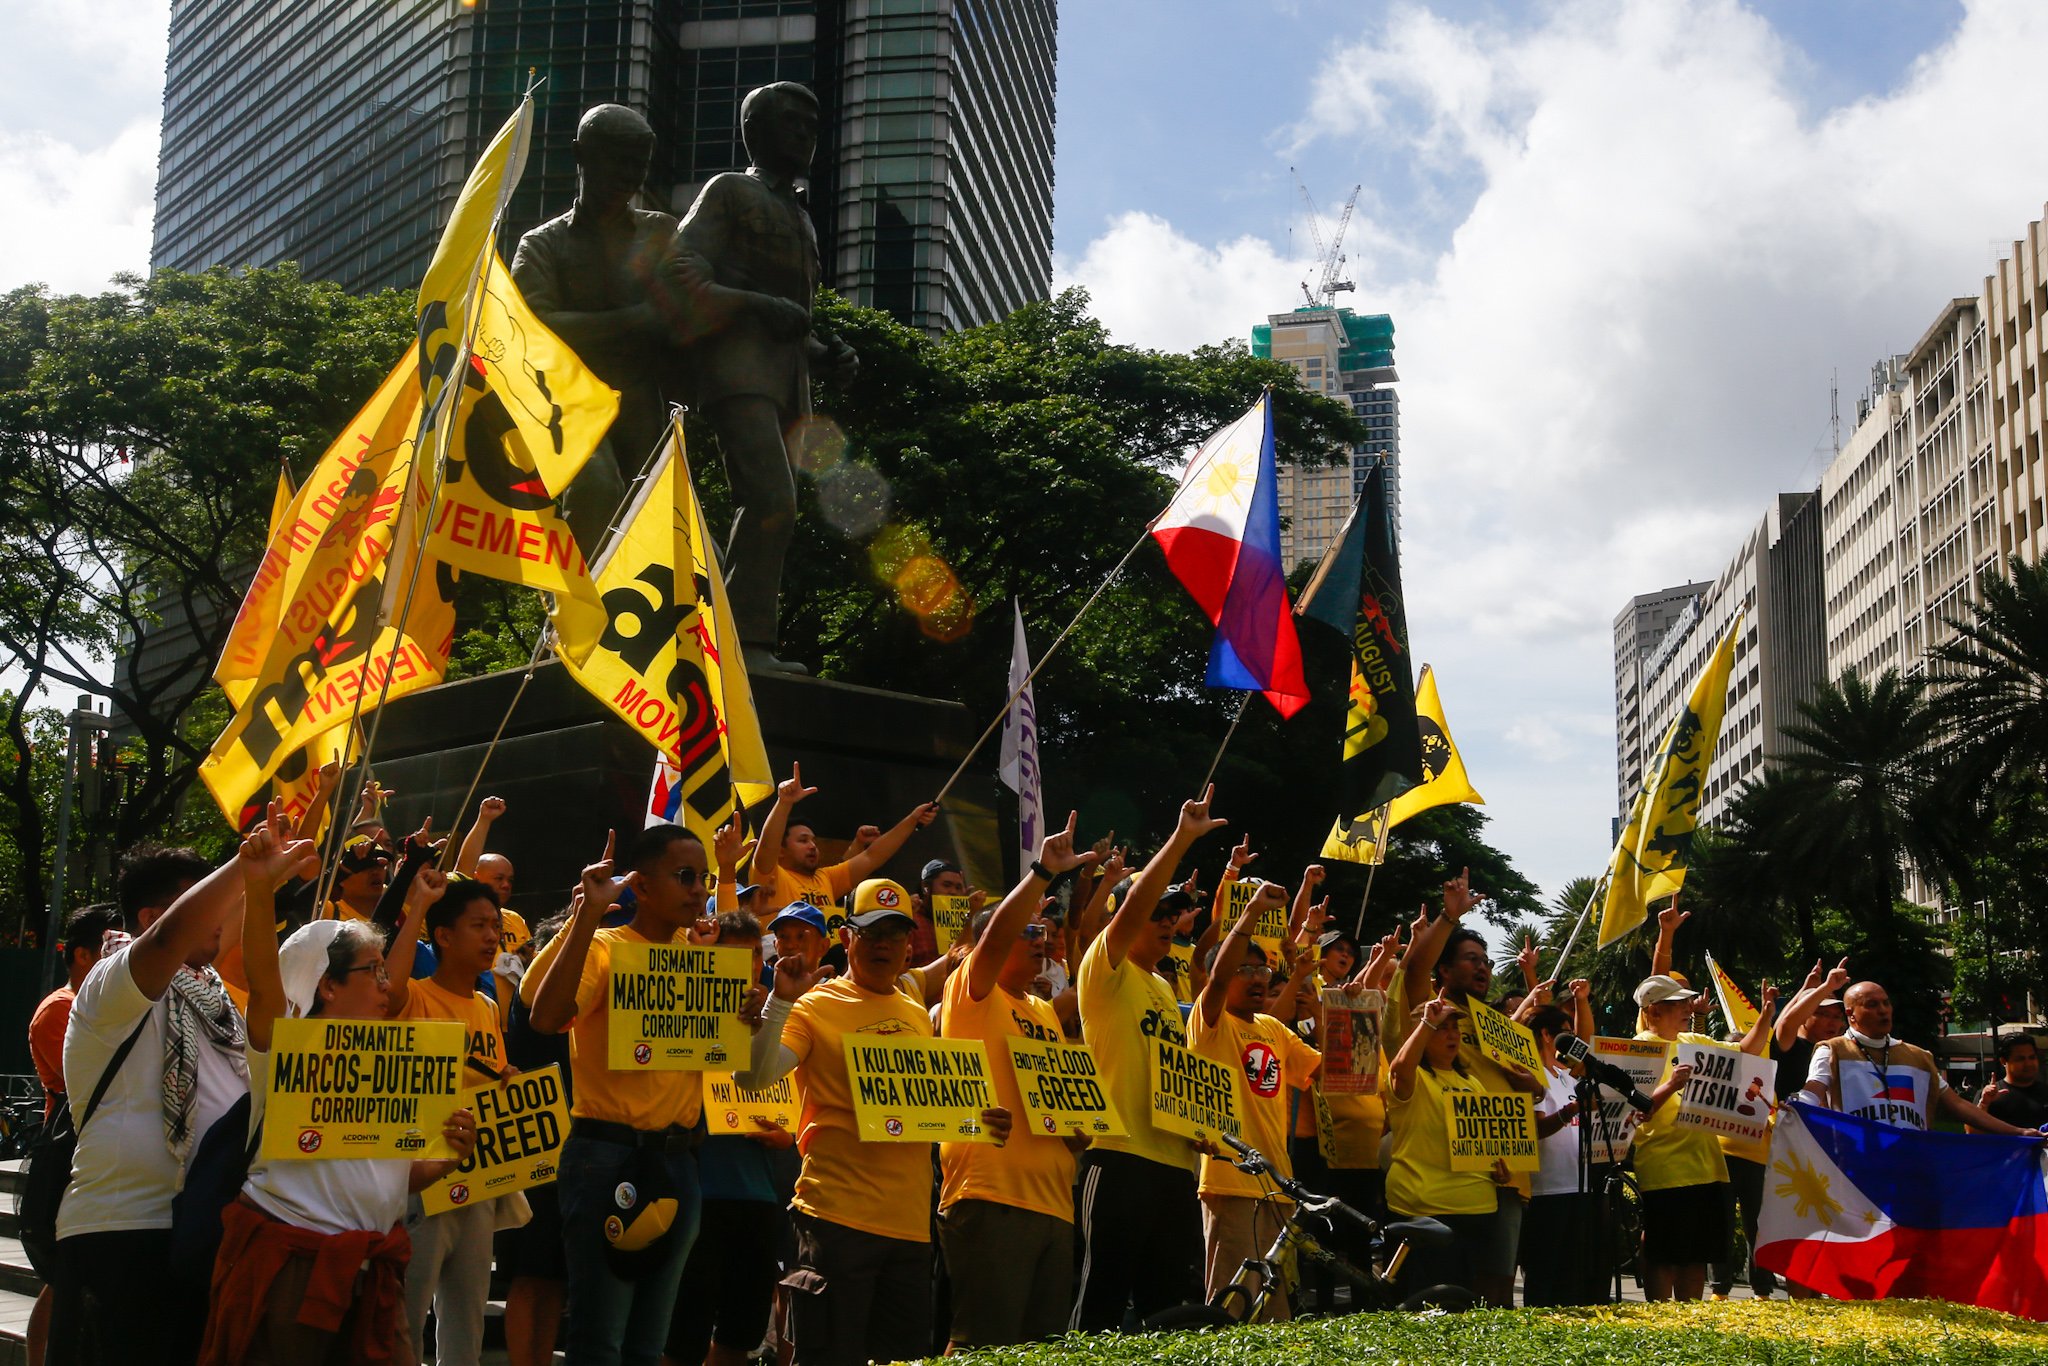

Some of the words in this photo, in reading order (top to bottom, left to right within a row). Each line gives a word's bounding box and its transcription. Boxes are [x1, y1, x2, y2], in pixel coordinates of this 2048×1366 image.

[1354, 621, 1397, 695] AUGUST
[649, 948, 715, 975] DISMANTLE
[614, 973, 747, 1014] MARCOS-DUTERTE
[325, 1024, 415, 1052] DISMANTLE
[642, 1014, 719, 1039] CORRUPTION!
[1475, 1011, 1533, 1057] CORRUPT
[705, 1051, 727, 1062] atom
[852, 1047, 860, 1072] I
[862, 1047, 926, 1074] KULONG
[928, 1050, 953, 1076] NA
[951, 1051, 984, 1077] YAN
[1013, 1051, 1032, 1069] END
[1031, 1054, 1049, 1072] THE
[1045, 1047, 1096, 1076] FLOOD
[1600, 1042, 1628, 1052] TINDIG
[1629, 1044, 1663, 1055] PILIPINAS
[274, 1053, 458, 1095] MARCOS-DUTERTE
[1159, 1043, 1232, 1092] MARCOS
[1694, 1051, 1735, 1081] SARA
[476, 1075, 558, 1123] FLOOD
[711, 1083, 731, 1103] MAY
[858, 1076, 901, 1106] MGA
[902, 1077, 990, 1108] KURAKOT!
[1028, 1091, 1040, 1109] OF
[1037, 1074, 1106, 1111] GREED
[1160, 1068, 1234, 1117] DUTERTE
[1452, 1095, 1526, 1118] MARCOS
[1682, 1079, 1739, 1111] ITISIN
[311, 1097, 418, 1123] CORRUPTION!
[1155, 1091, 1176, 1115] SAKIT
[1179, 1100, 1189, 1120] SA
[1191, 1105, 1204, 1125] ULO
[1206, 1110, 1215, 1129] NG
[1218, 1115, 1242, 1139] BAYAN!
[342, 1134, 380, 1142] ACRONYM
[395, 1137, 425, 1149] atom
[1456, 1118, 1529, 1140] DUTERTE
[1702, 1117, 1764, 1139] PILIPINAS
[1452, 1140, 1473, 1156] SAKIT
[1474, 1140, 1484, 1156] SA
[1486, 1140, 1499, 1156] ULO
[1500, 1140, 1511, 1156] NG
[1512, 1140, 1536, 1156] BAYAN!
[485, 1173, 516, 1187] ACRONYM
[530, 1165, 555, 1180] atom
